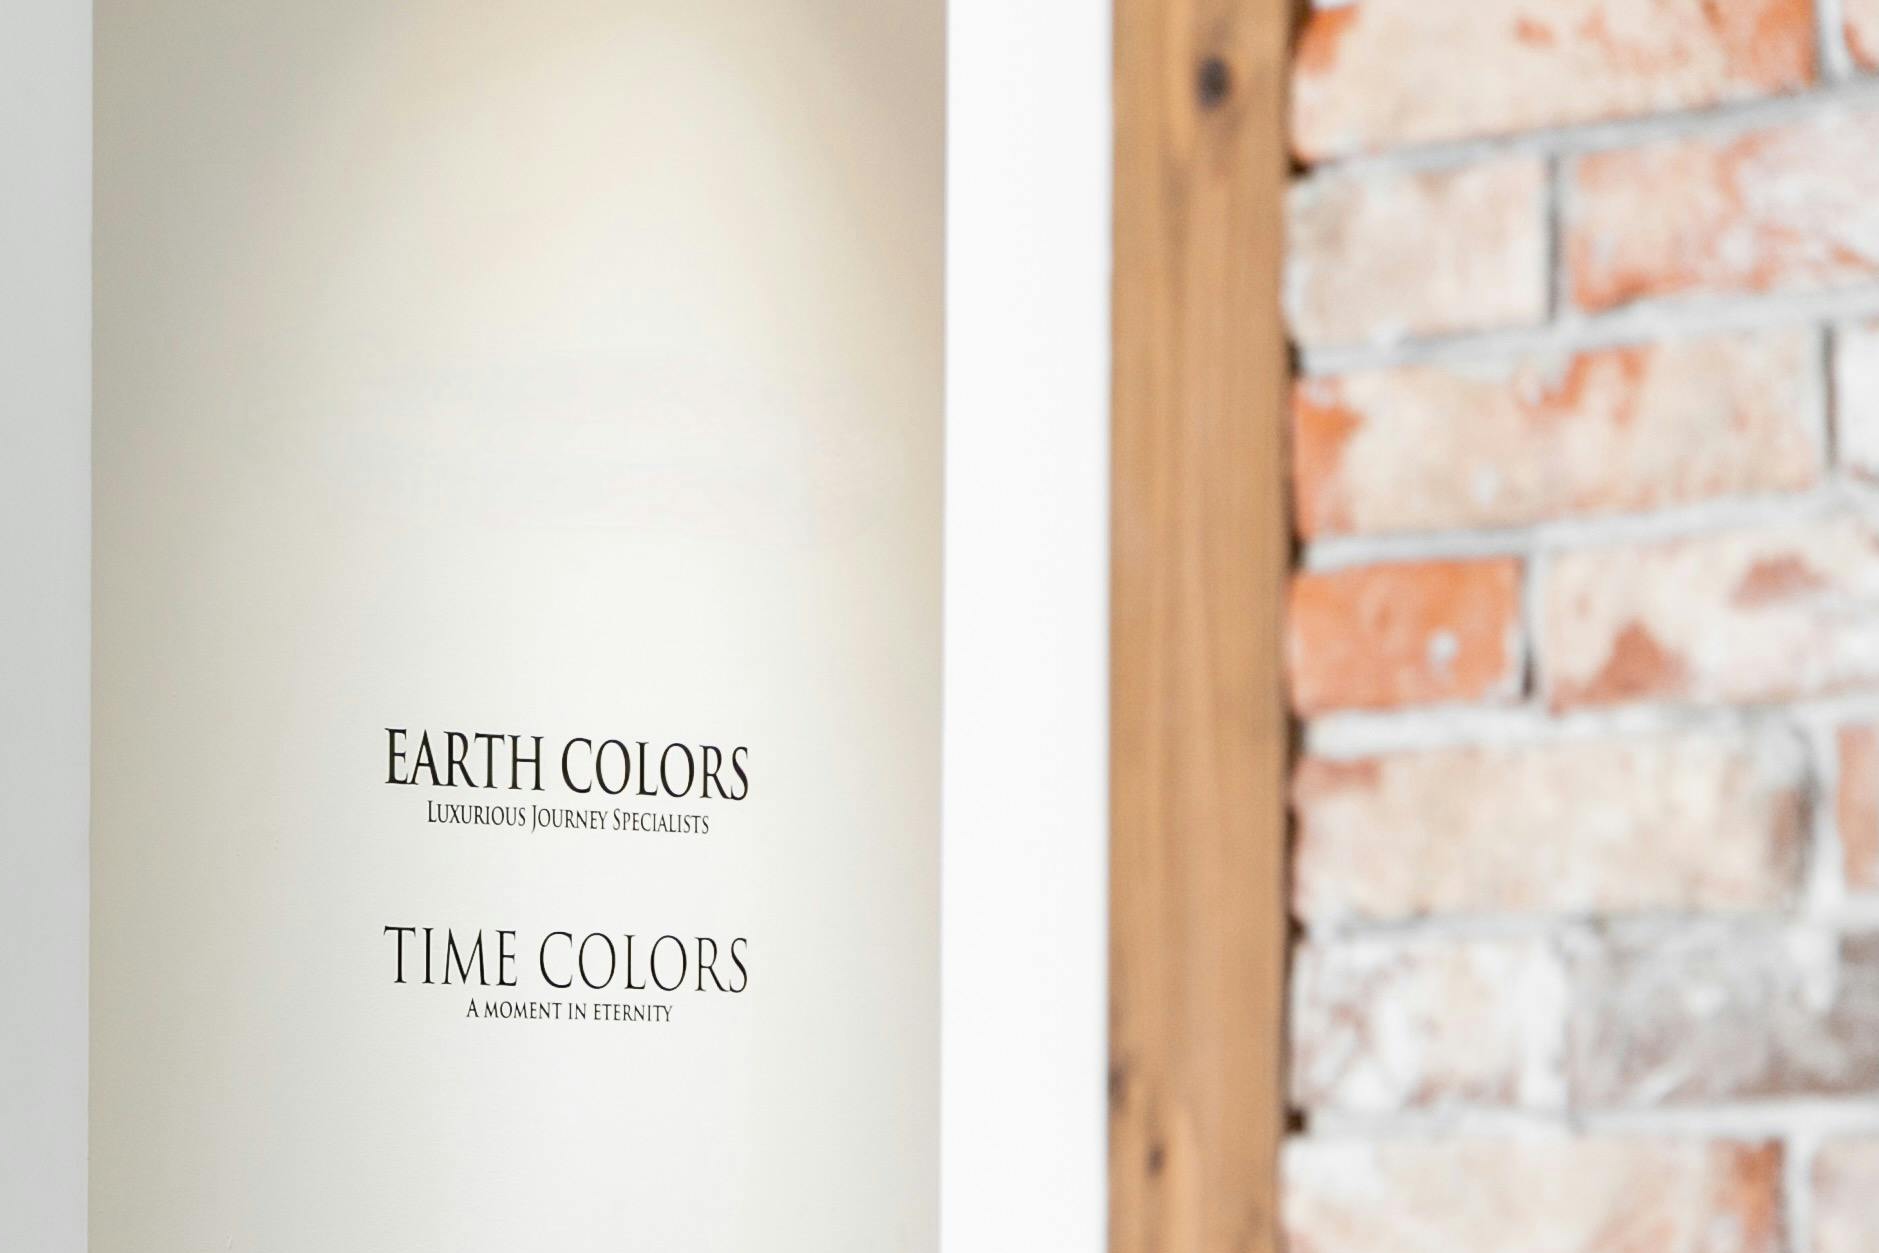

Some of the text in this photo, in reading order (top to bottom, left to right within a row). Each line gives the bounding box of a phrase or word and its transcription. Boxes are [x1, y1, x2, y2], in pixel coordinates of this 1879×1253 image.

[384, 727, 749, 802] EARTH COLORS
[427, 799, 710, 835] LUXURIOUS JOURNEY SPECIALISTS
[383, 925, 748, 994] TIME COLORS
[465, 997, 673, 1023] A MOMENT IN ETERNITY
